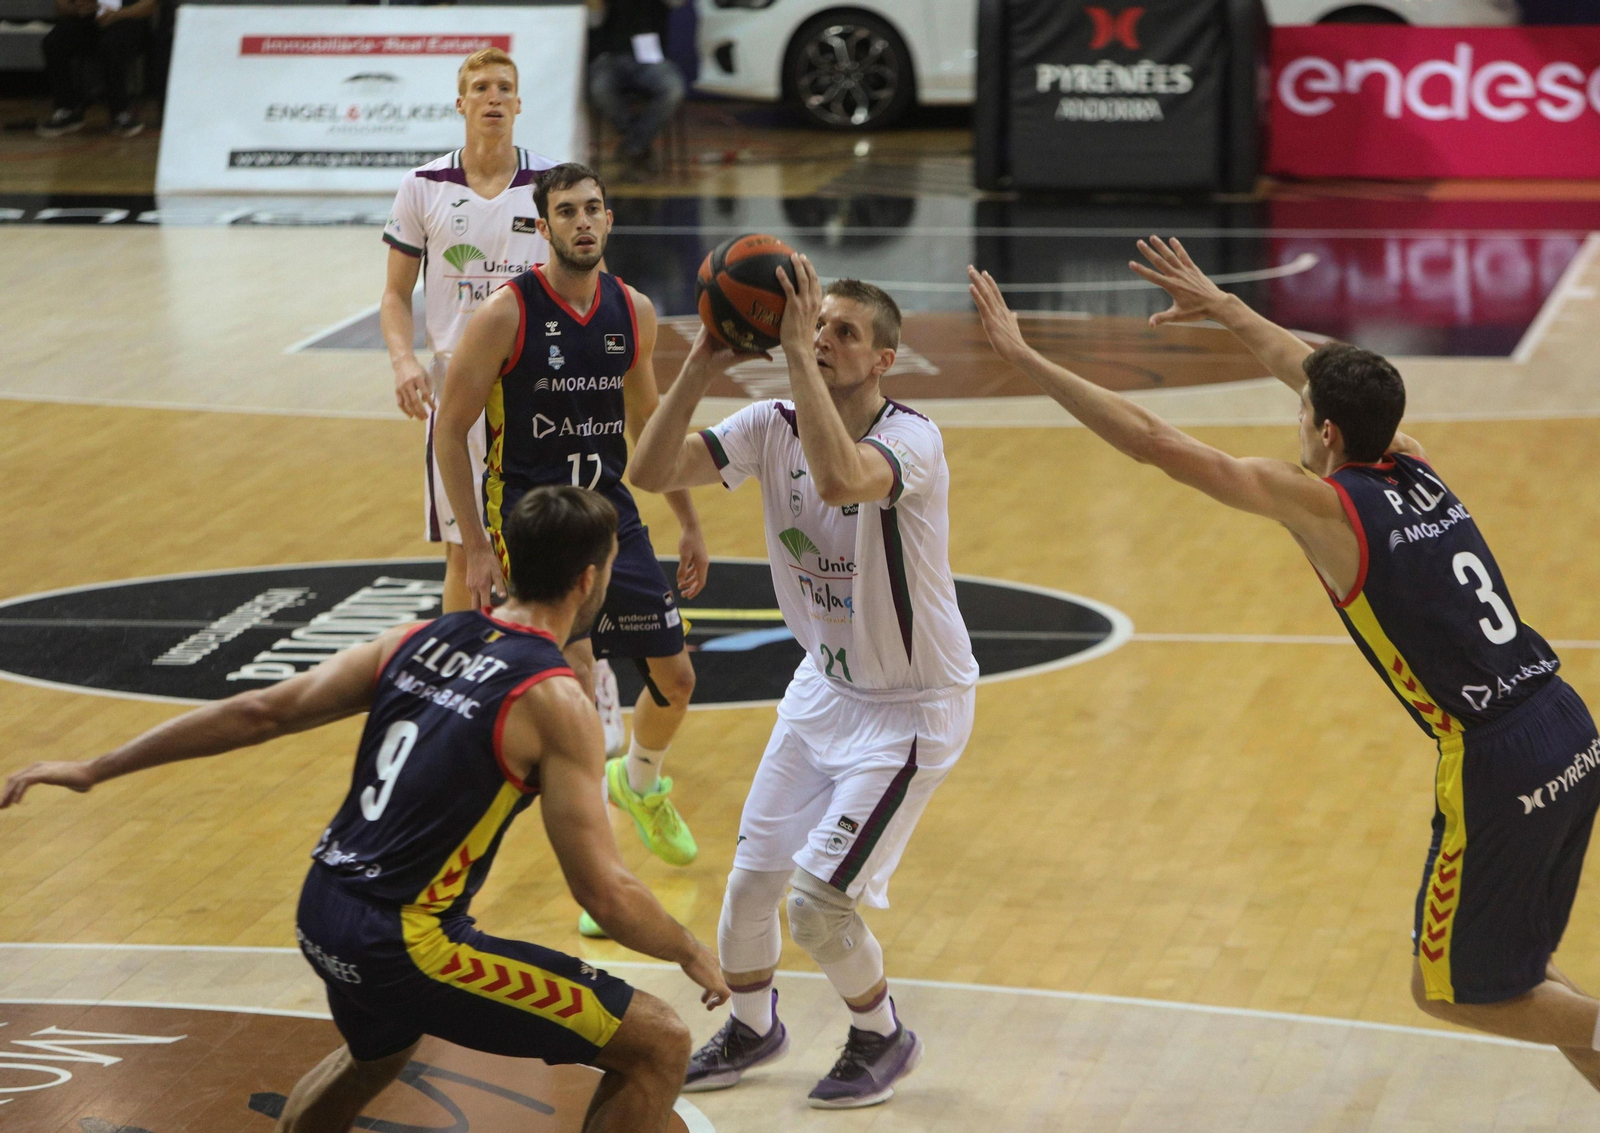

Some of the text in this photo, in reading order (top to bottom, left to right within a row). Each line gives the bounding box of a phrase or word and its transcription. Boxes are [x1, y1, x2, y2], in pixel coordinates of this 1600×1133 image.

[1277, 41, 1600, 123] endes
[618, 613, 659, 623] andorra
[1452, 551, 1518, 645] 3
[619, 622, 661, 632] telecom
[360, 720, 419, 822] 9
[839, 819, 854, 832] acb
